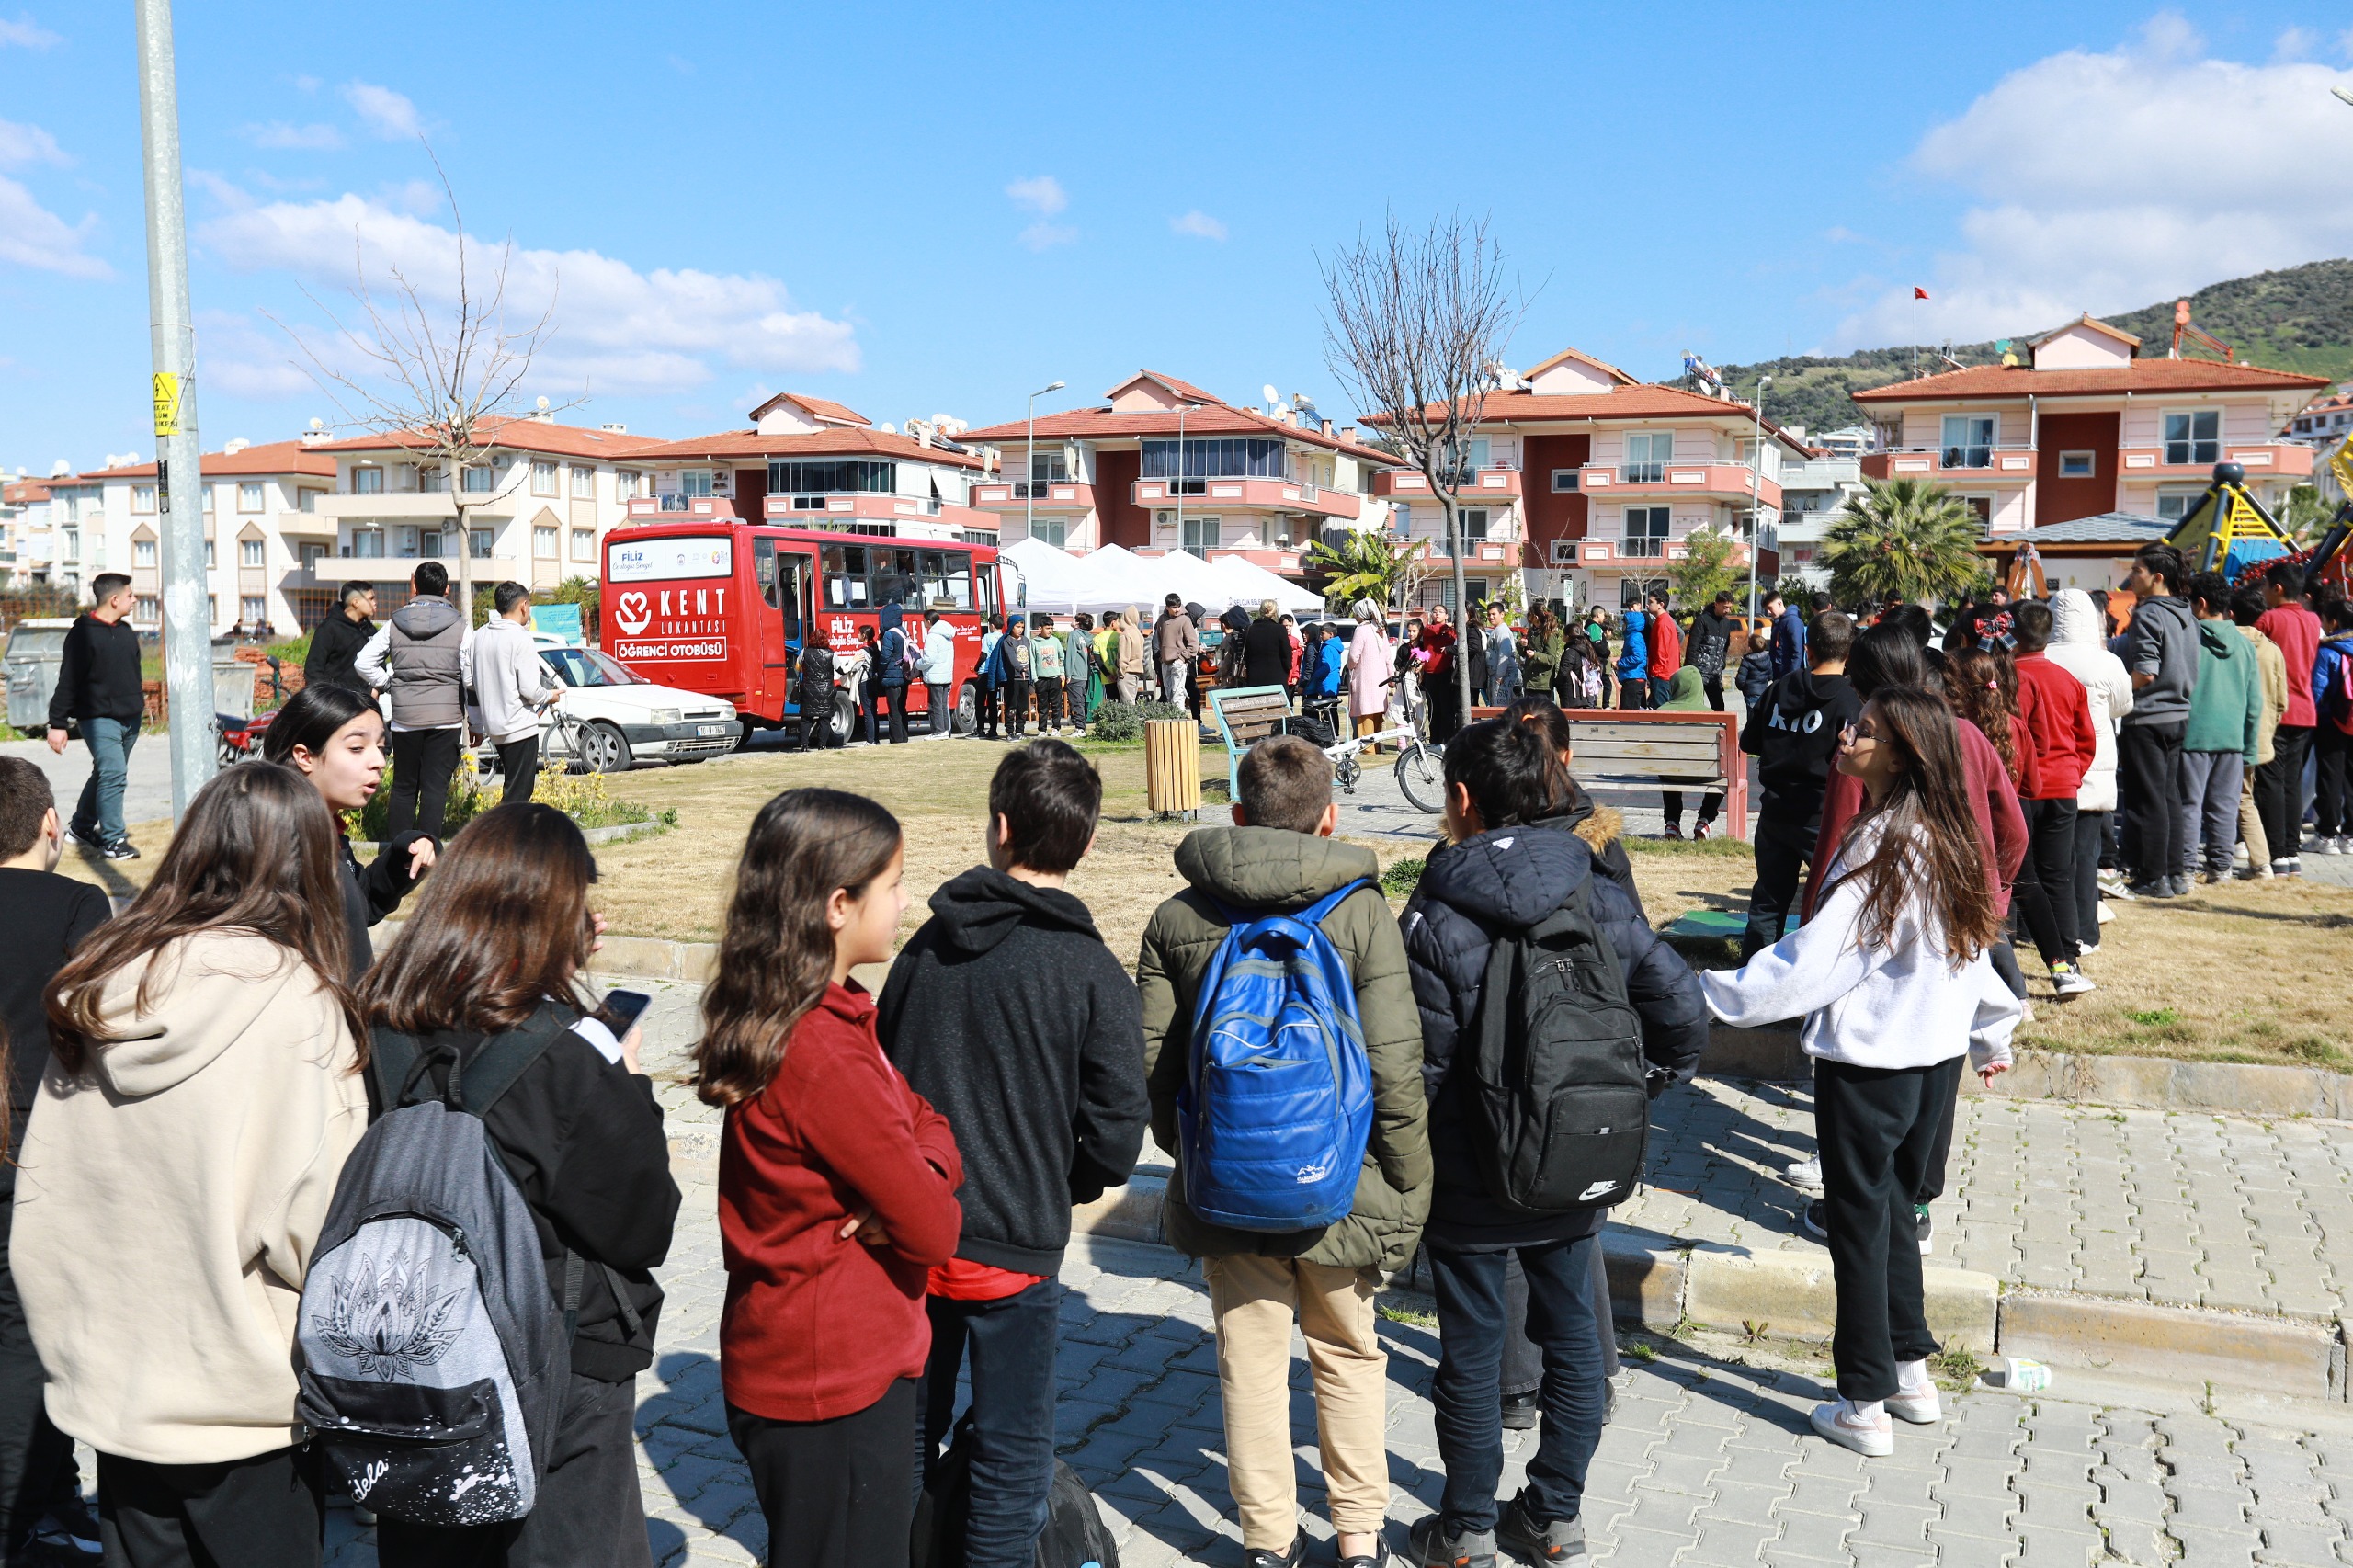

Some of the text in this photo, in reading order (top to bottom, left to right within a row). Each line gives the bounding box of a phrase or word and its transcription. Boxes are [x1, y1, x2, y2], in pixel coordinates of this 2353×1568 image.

[622, 551, 643, 562] FİLİZ
[660, 588, 725, 616] KENT
[661, 619, 725, 634] LOKANTASI
[831, 615, 855, 634] FİLİZ
[619, 642, 722, 657] ÖĞRENCİ OTOBÜSÜ
[1586, 1180, 1616, 1193] NIKE
